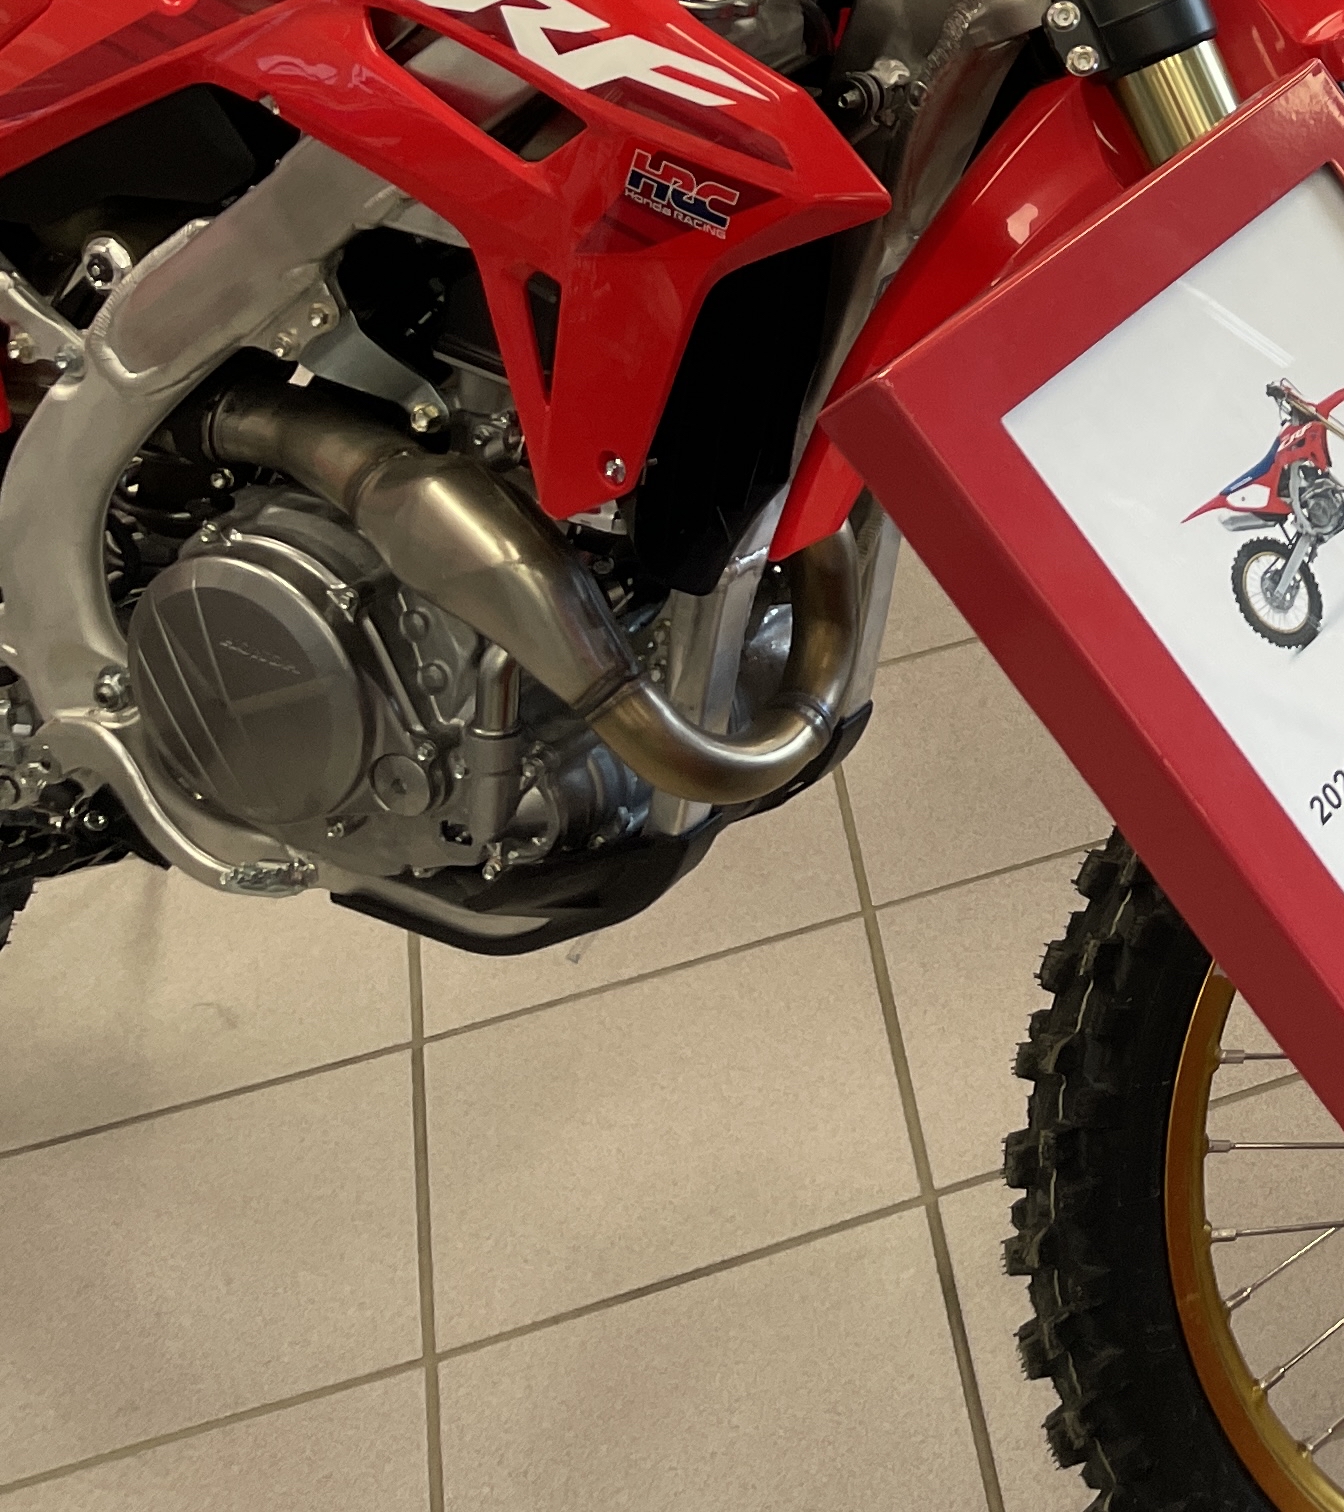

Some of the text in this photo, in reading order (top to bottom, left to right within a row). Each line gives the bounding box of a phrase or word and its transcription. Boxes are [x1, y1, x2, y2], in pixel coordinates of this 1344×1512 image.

[624, 187, 727, 241] Honda RACING
[625, 147, 741, 230] HRC
